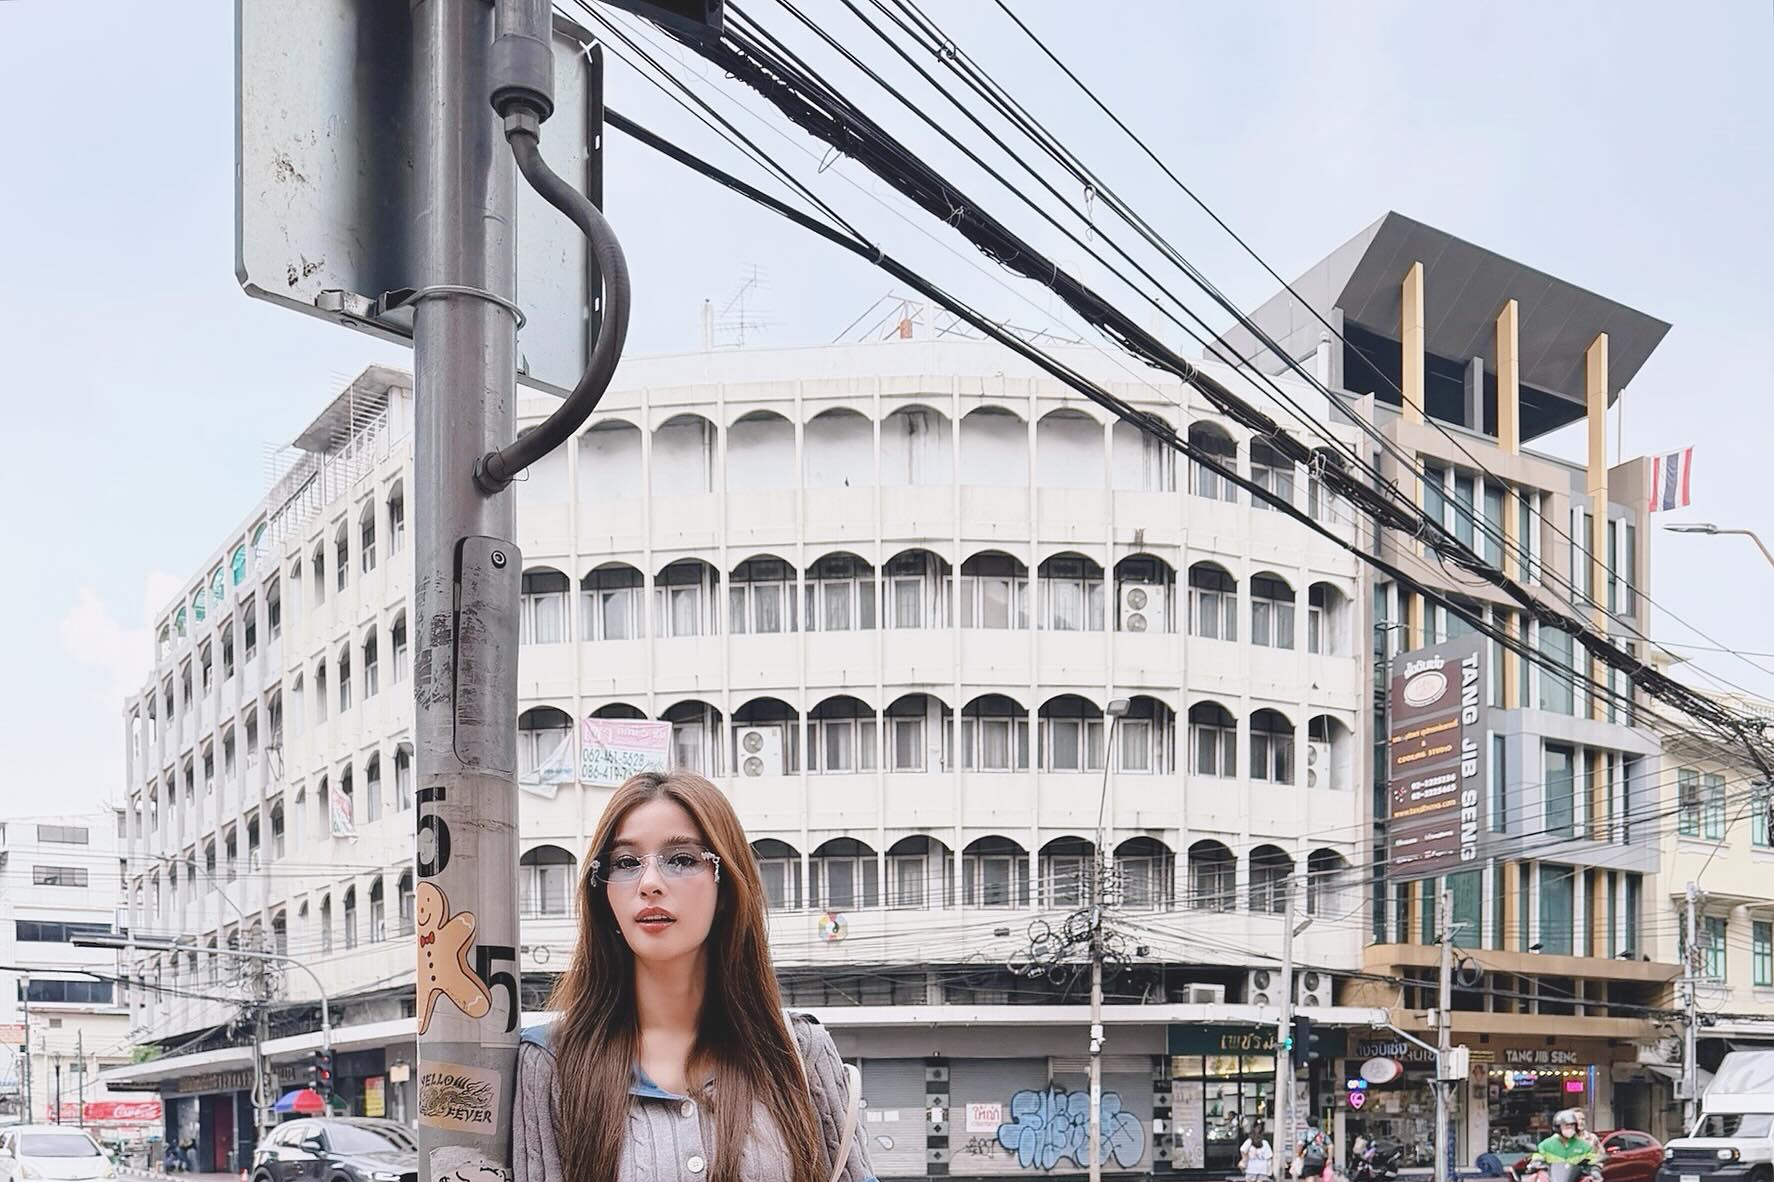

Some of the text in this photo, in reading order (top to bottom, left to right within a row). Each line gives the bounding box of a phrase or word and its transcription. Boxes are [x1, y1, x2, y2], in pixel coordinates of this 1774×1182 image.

[1461, 652, 1479, 861] TANG JIB SENG
[1506, 1050, 1577, 1063] TANG JIB SENG
[444, 1106, 492, 1123] FEVER
